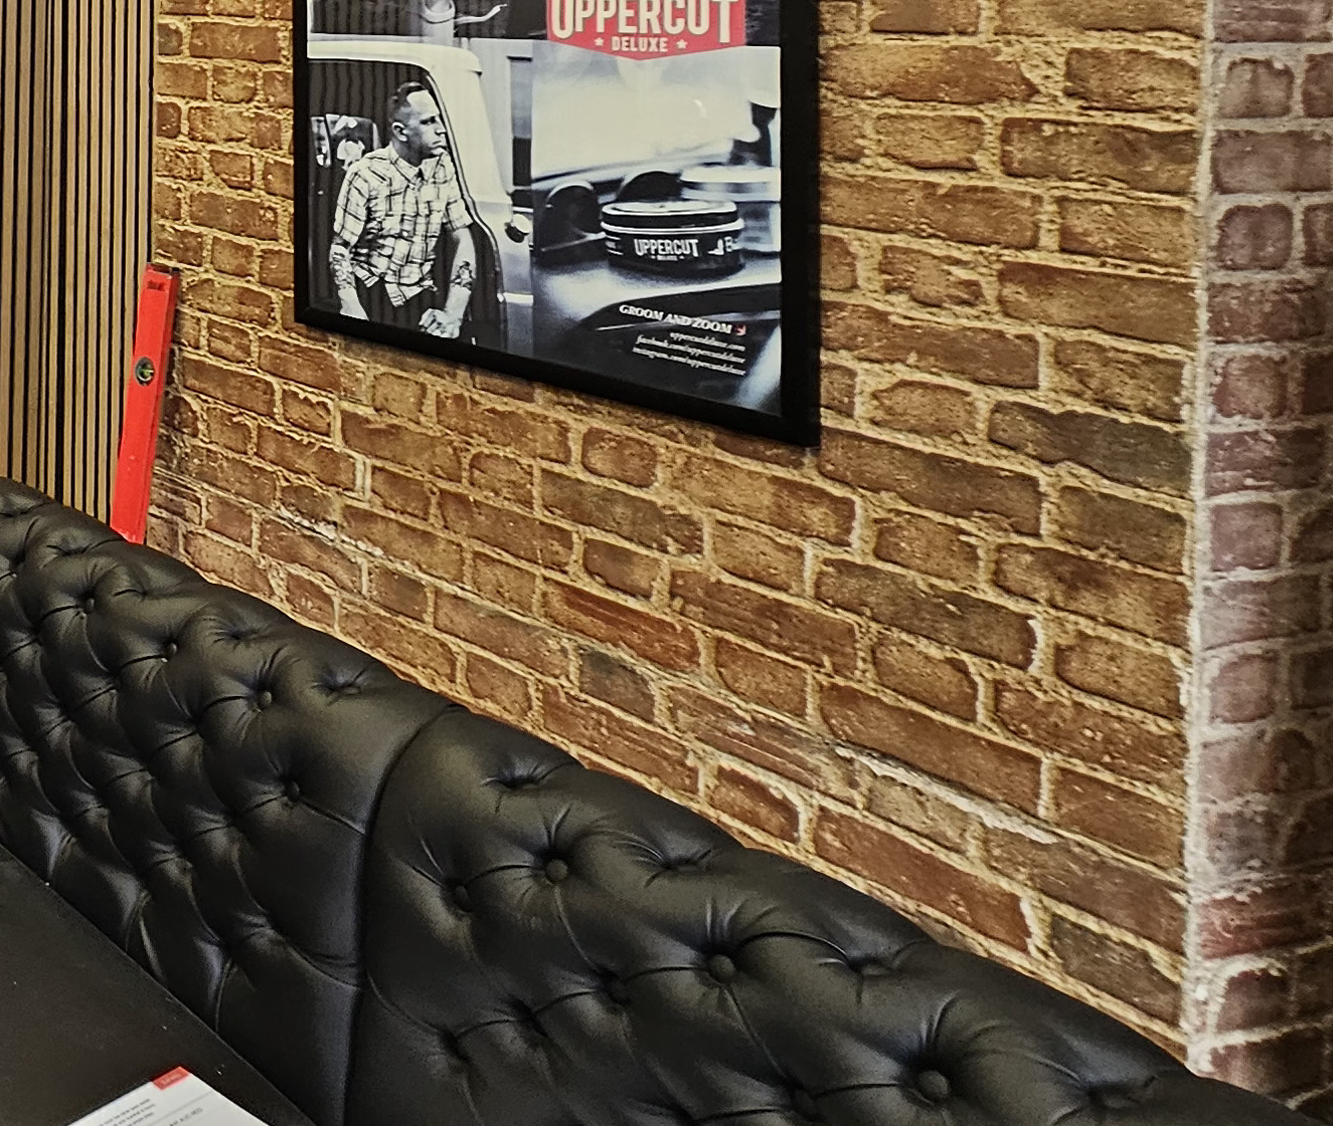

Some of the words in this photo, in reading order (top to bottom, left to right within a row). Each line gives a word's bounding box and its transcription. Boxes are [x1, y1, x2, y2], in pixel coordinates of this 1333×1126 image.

[611, 36, 669, 53] DELUXE
[633, 238, 699, 258] UPPERCUT
[619, 304, 664, 321] GROOM
[663, 313, 693, 327] AND
[691, 317, 733, 334] ZOOM
